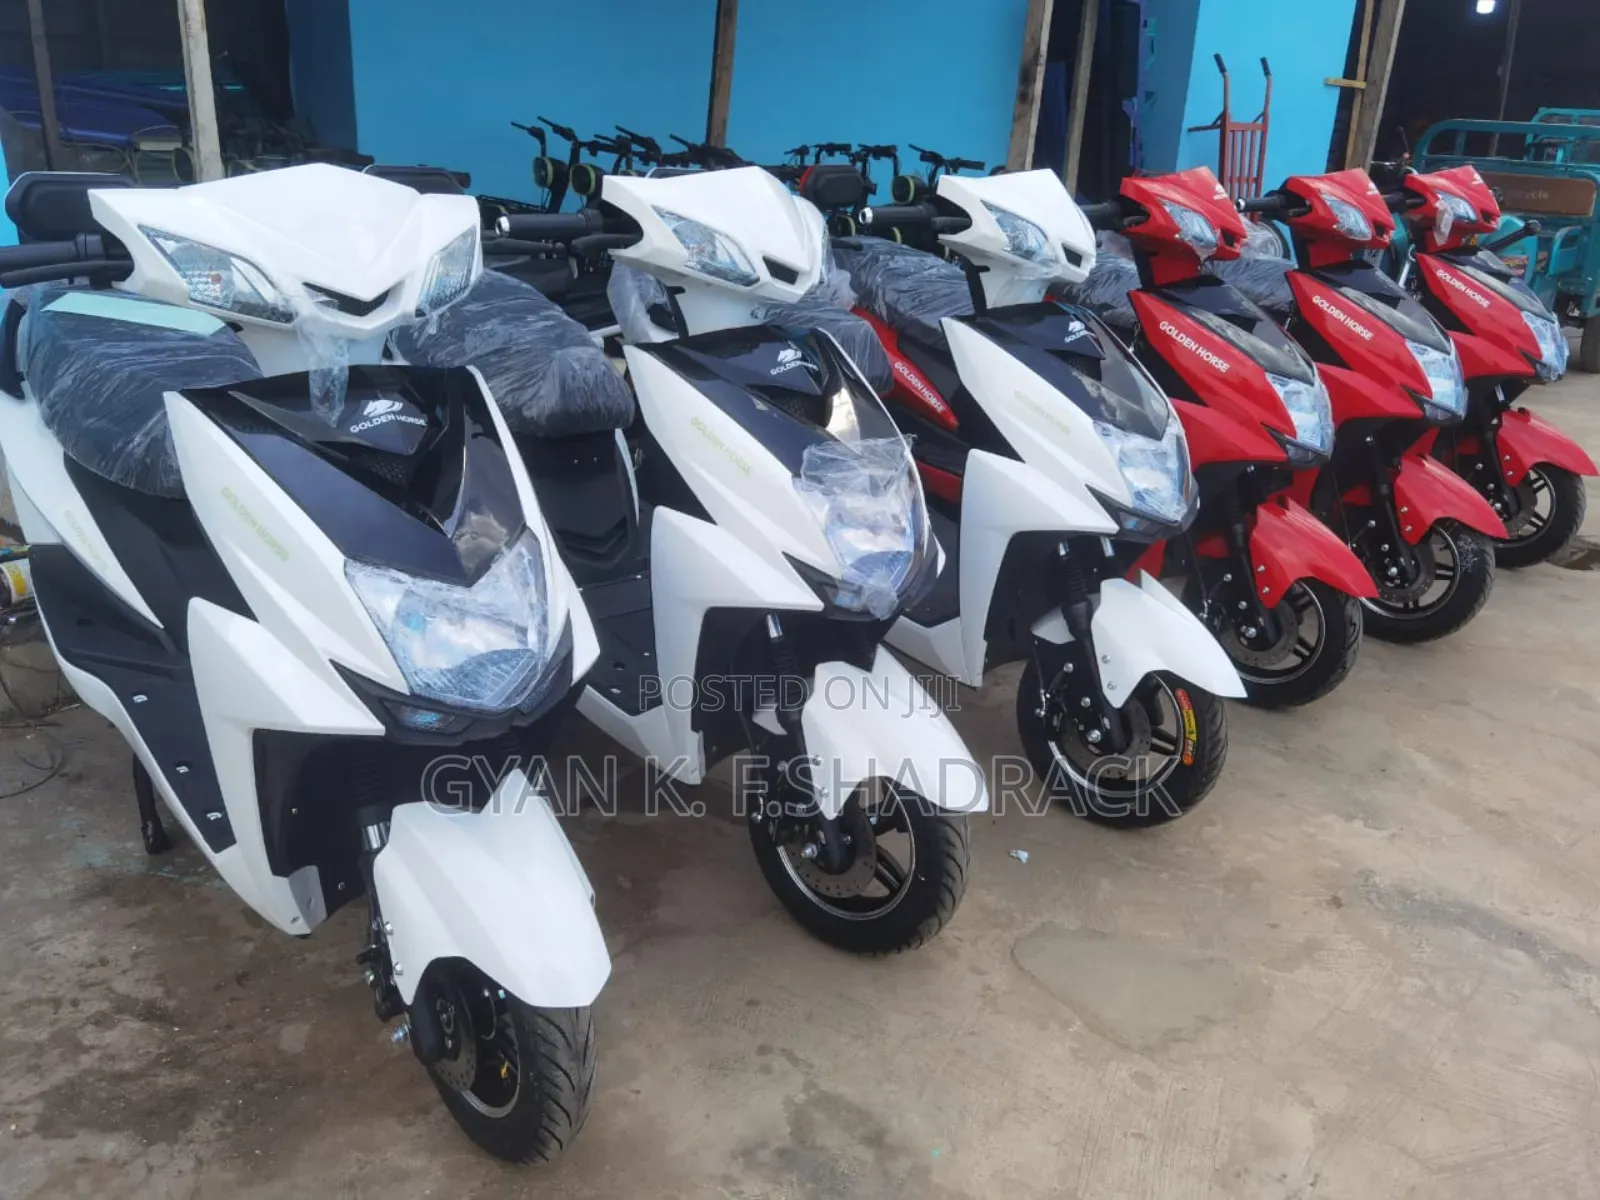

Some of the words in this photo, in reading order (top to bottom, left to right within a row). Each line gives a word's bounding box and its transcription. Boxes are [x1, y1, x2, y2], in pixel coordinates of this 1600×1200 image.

[1436, 269, 1467, 292] GOLDEN
[1464, 288, 1490, 308] HORSE
[1312, 295, 1347, 322] GOLDEN
[1344, 316, 1374, 341] HORSE
[1159, 320, 1199, 352] GOLDEN
[1196, 346, 1230, 373] HORSE
[895, 361, 924, 390] GOLDEN
[920, 387, 945, 413] HORSE
[350, 413, 396, 433] GOLDEN
